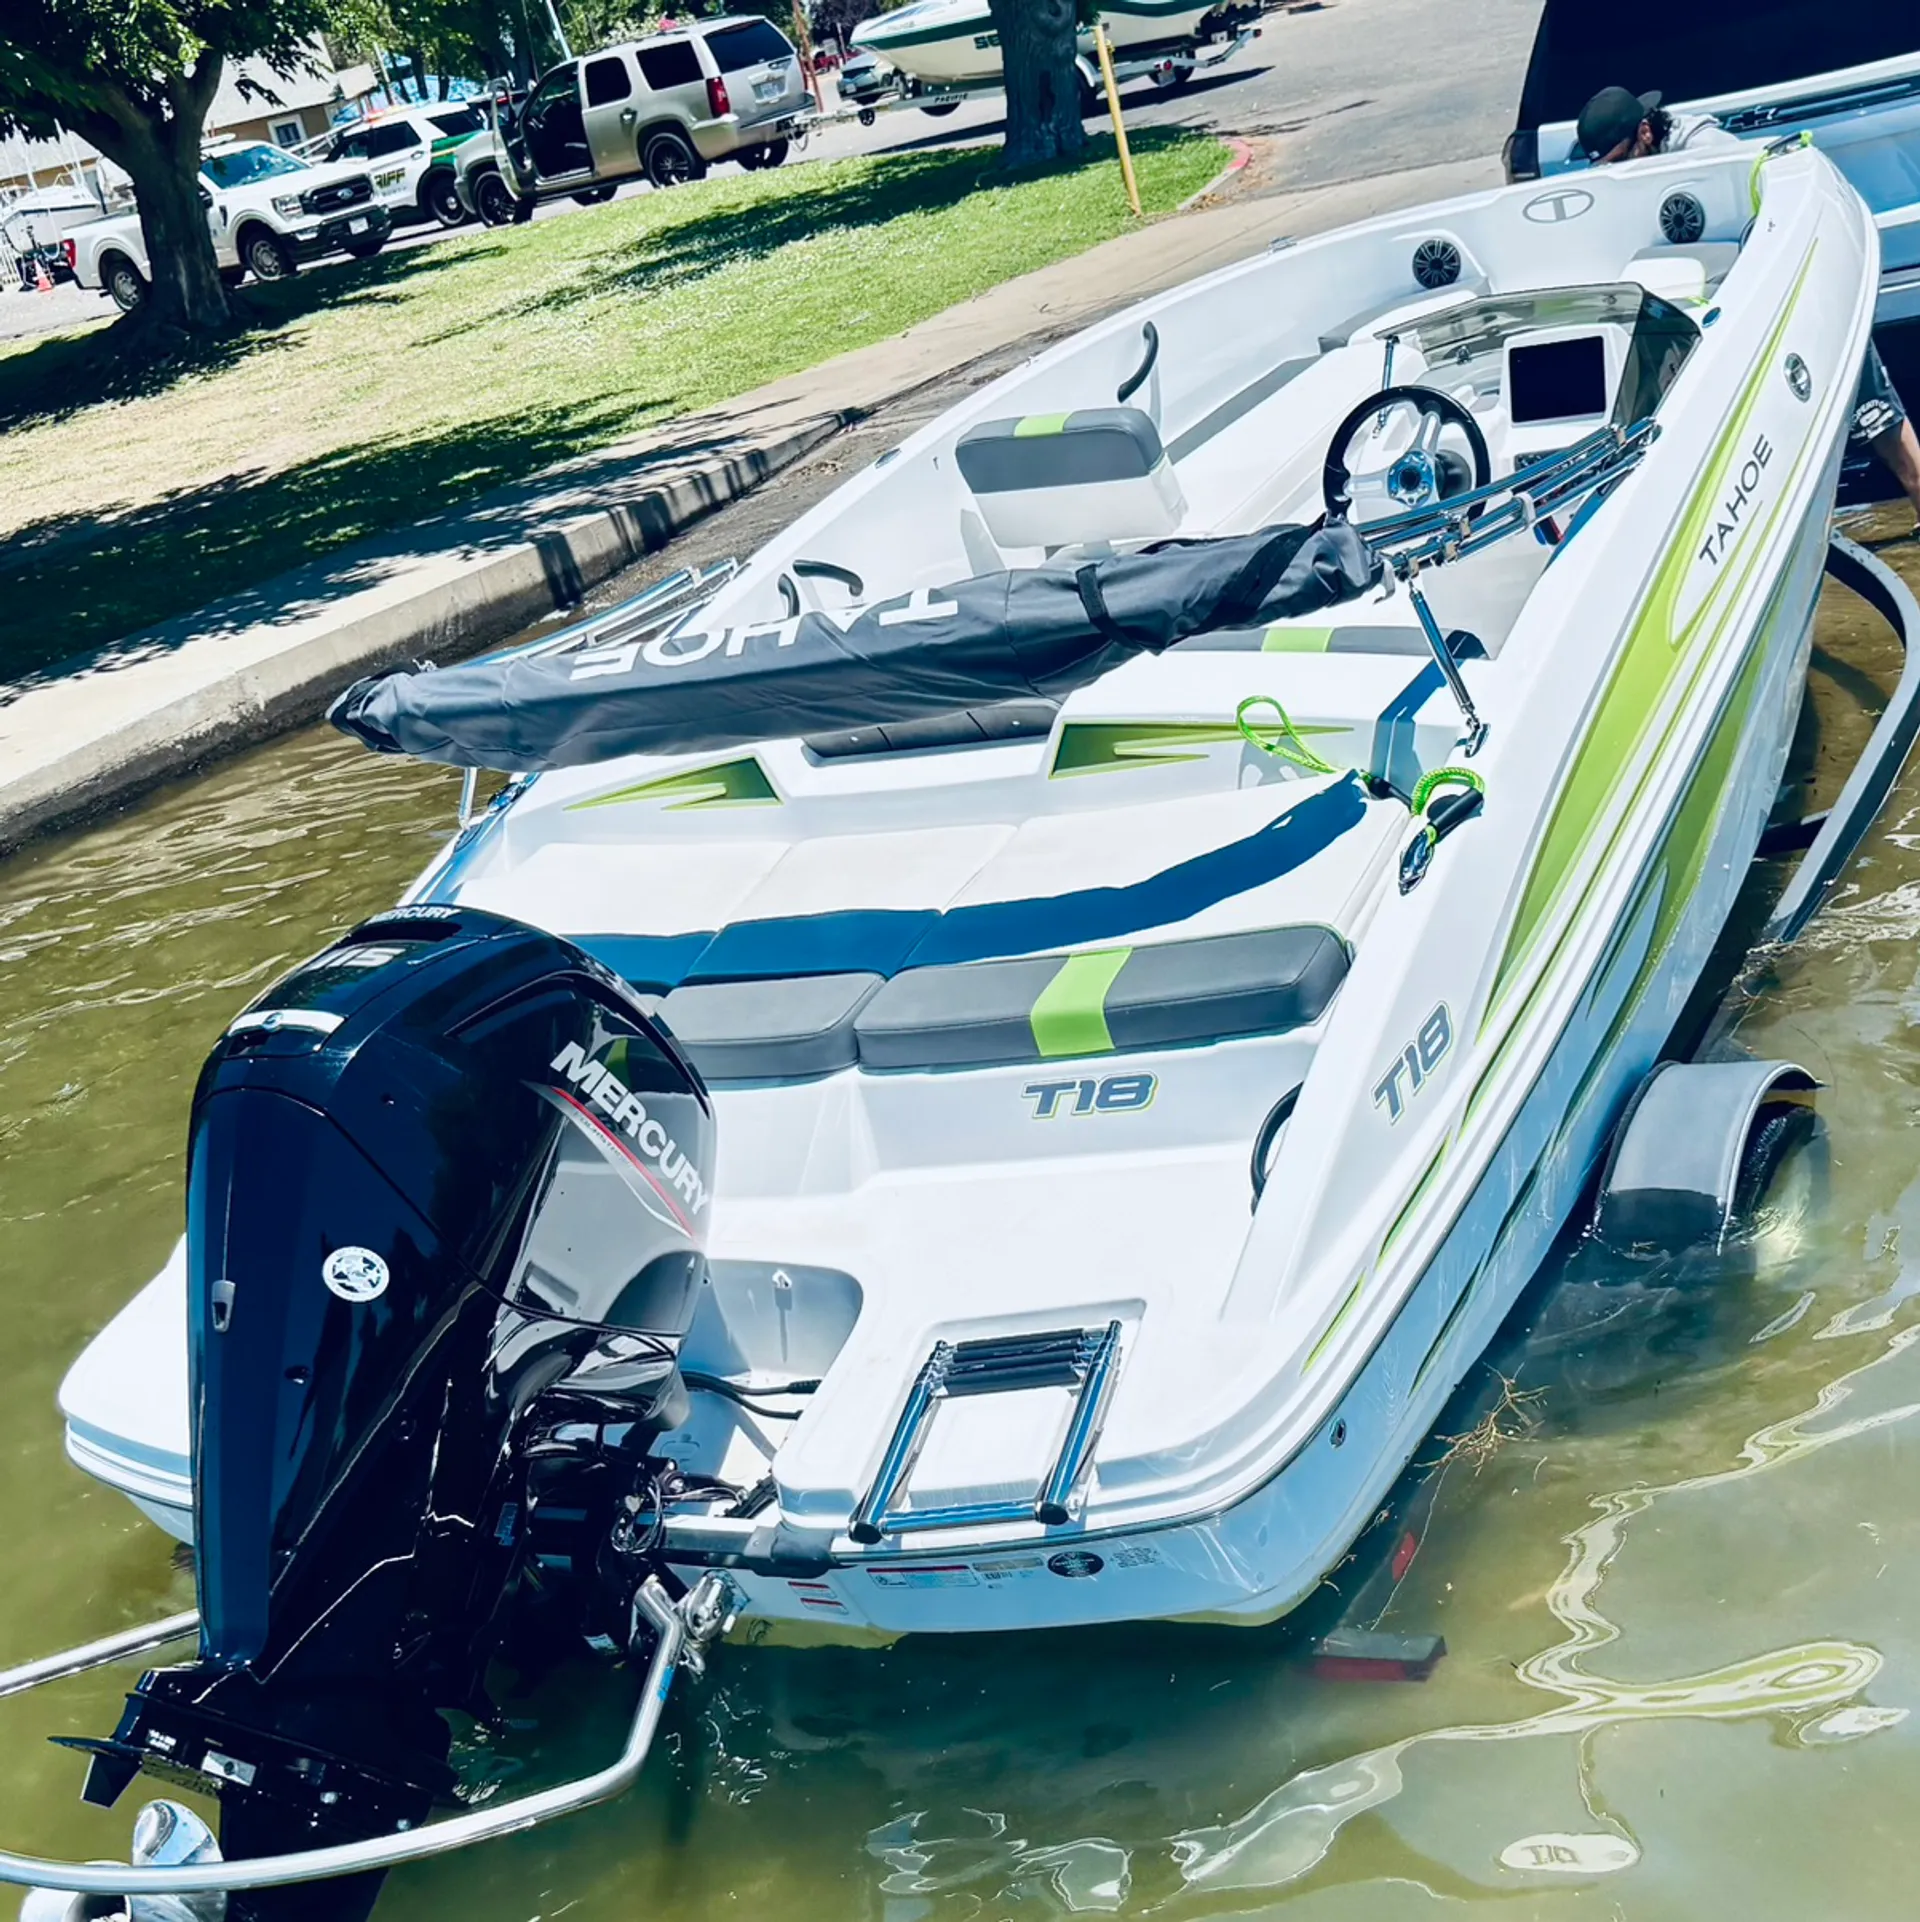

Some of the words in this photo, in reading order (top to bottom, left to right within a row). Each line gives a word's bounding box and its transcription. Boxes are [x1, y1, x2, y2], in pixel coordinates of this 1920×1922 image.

[1699, 433, 1774, 565] TAHOE
[550, 1040, 709, 1215] MERCURY
[1022, 1071, 1159, 1119] T18
[1370, 1000, 1452, 1126] T18
